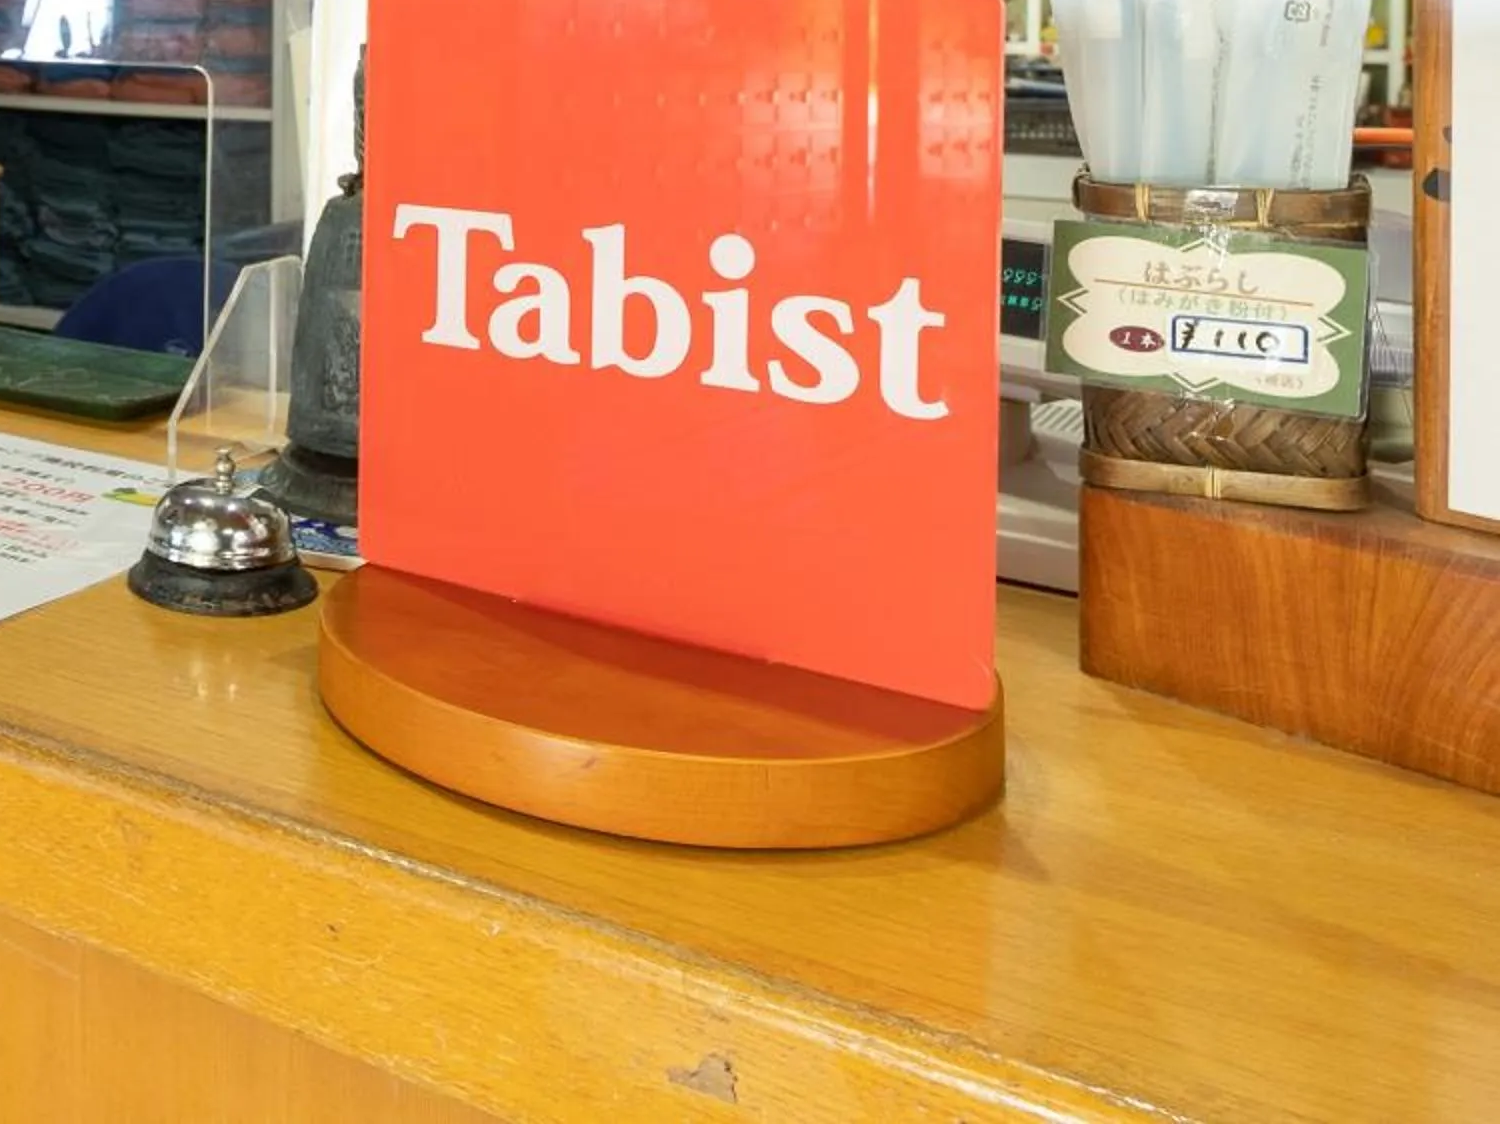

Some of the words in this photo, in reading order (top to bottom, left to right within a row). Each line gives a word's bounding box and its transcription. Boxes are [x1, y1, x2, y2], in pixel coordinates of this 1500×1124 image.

[392, 203, 949, 420] Tabist
[1143, 261, 1259, 295] はぶらし
